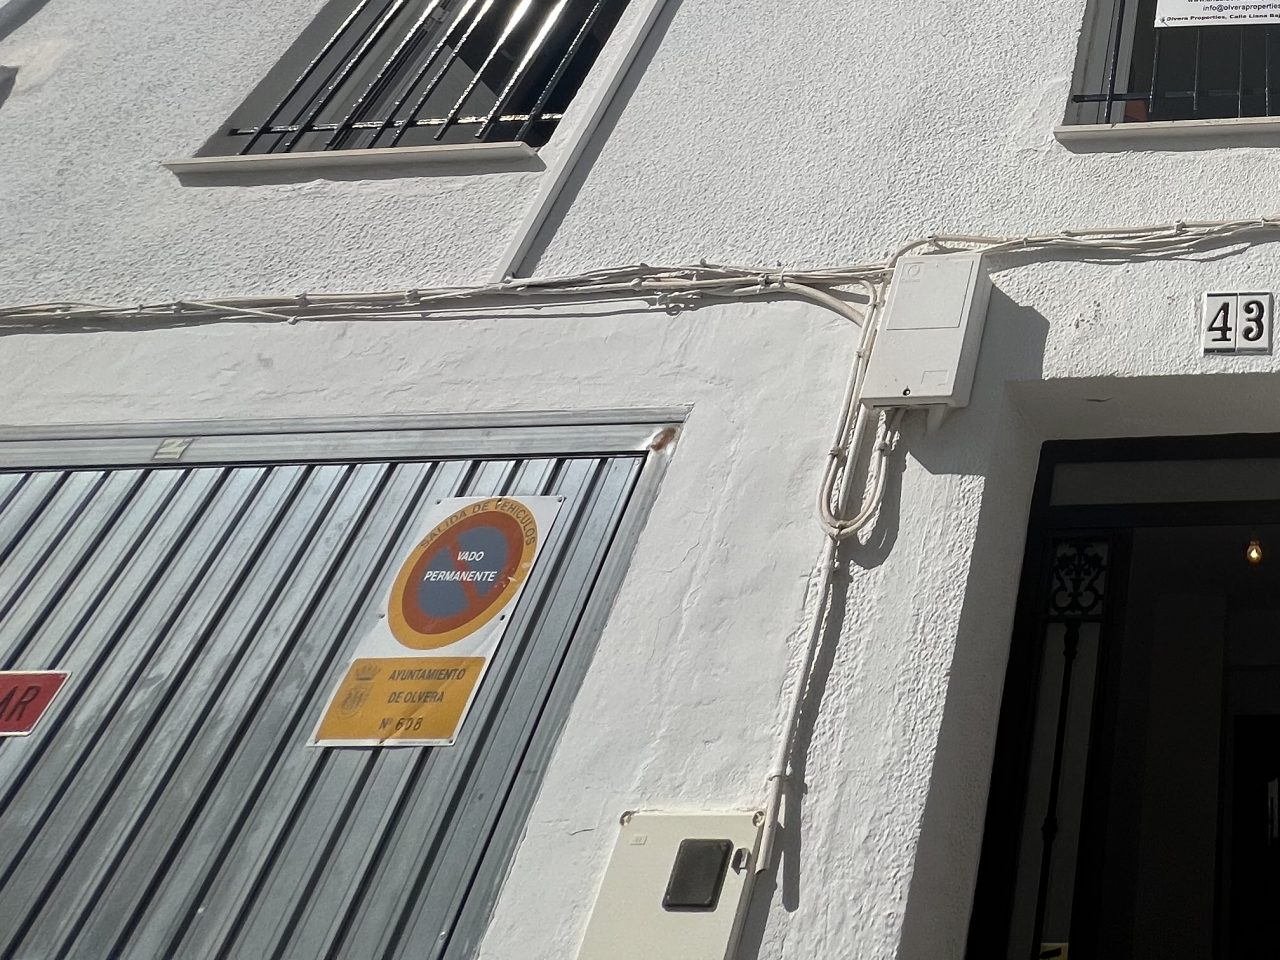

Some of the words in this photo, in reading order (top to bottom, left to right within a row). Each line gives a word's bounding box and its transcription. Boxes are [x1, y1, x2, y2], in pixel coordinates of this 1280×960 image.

[1206, 300, 1265, 342] 43
[420, 509, 467, 547] SALIDA
[472, 502, 489, 513] DE
[457, 551, 485, 561] VADO
[423, 570, 498, 582] PERMANENTE
[388, 669, 466, 681] AYUNTAMIENTO
[388, 691, 402, 704] DE
[403, 691, 445, 704] OLVERA
